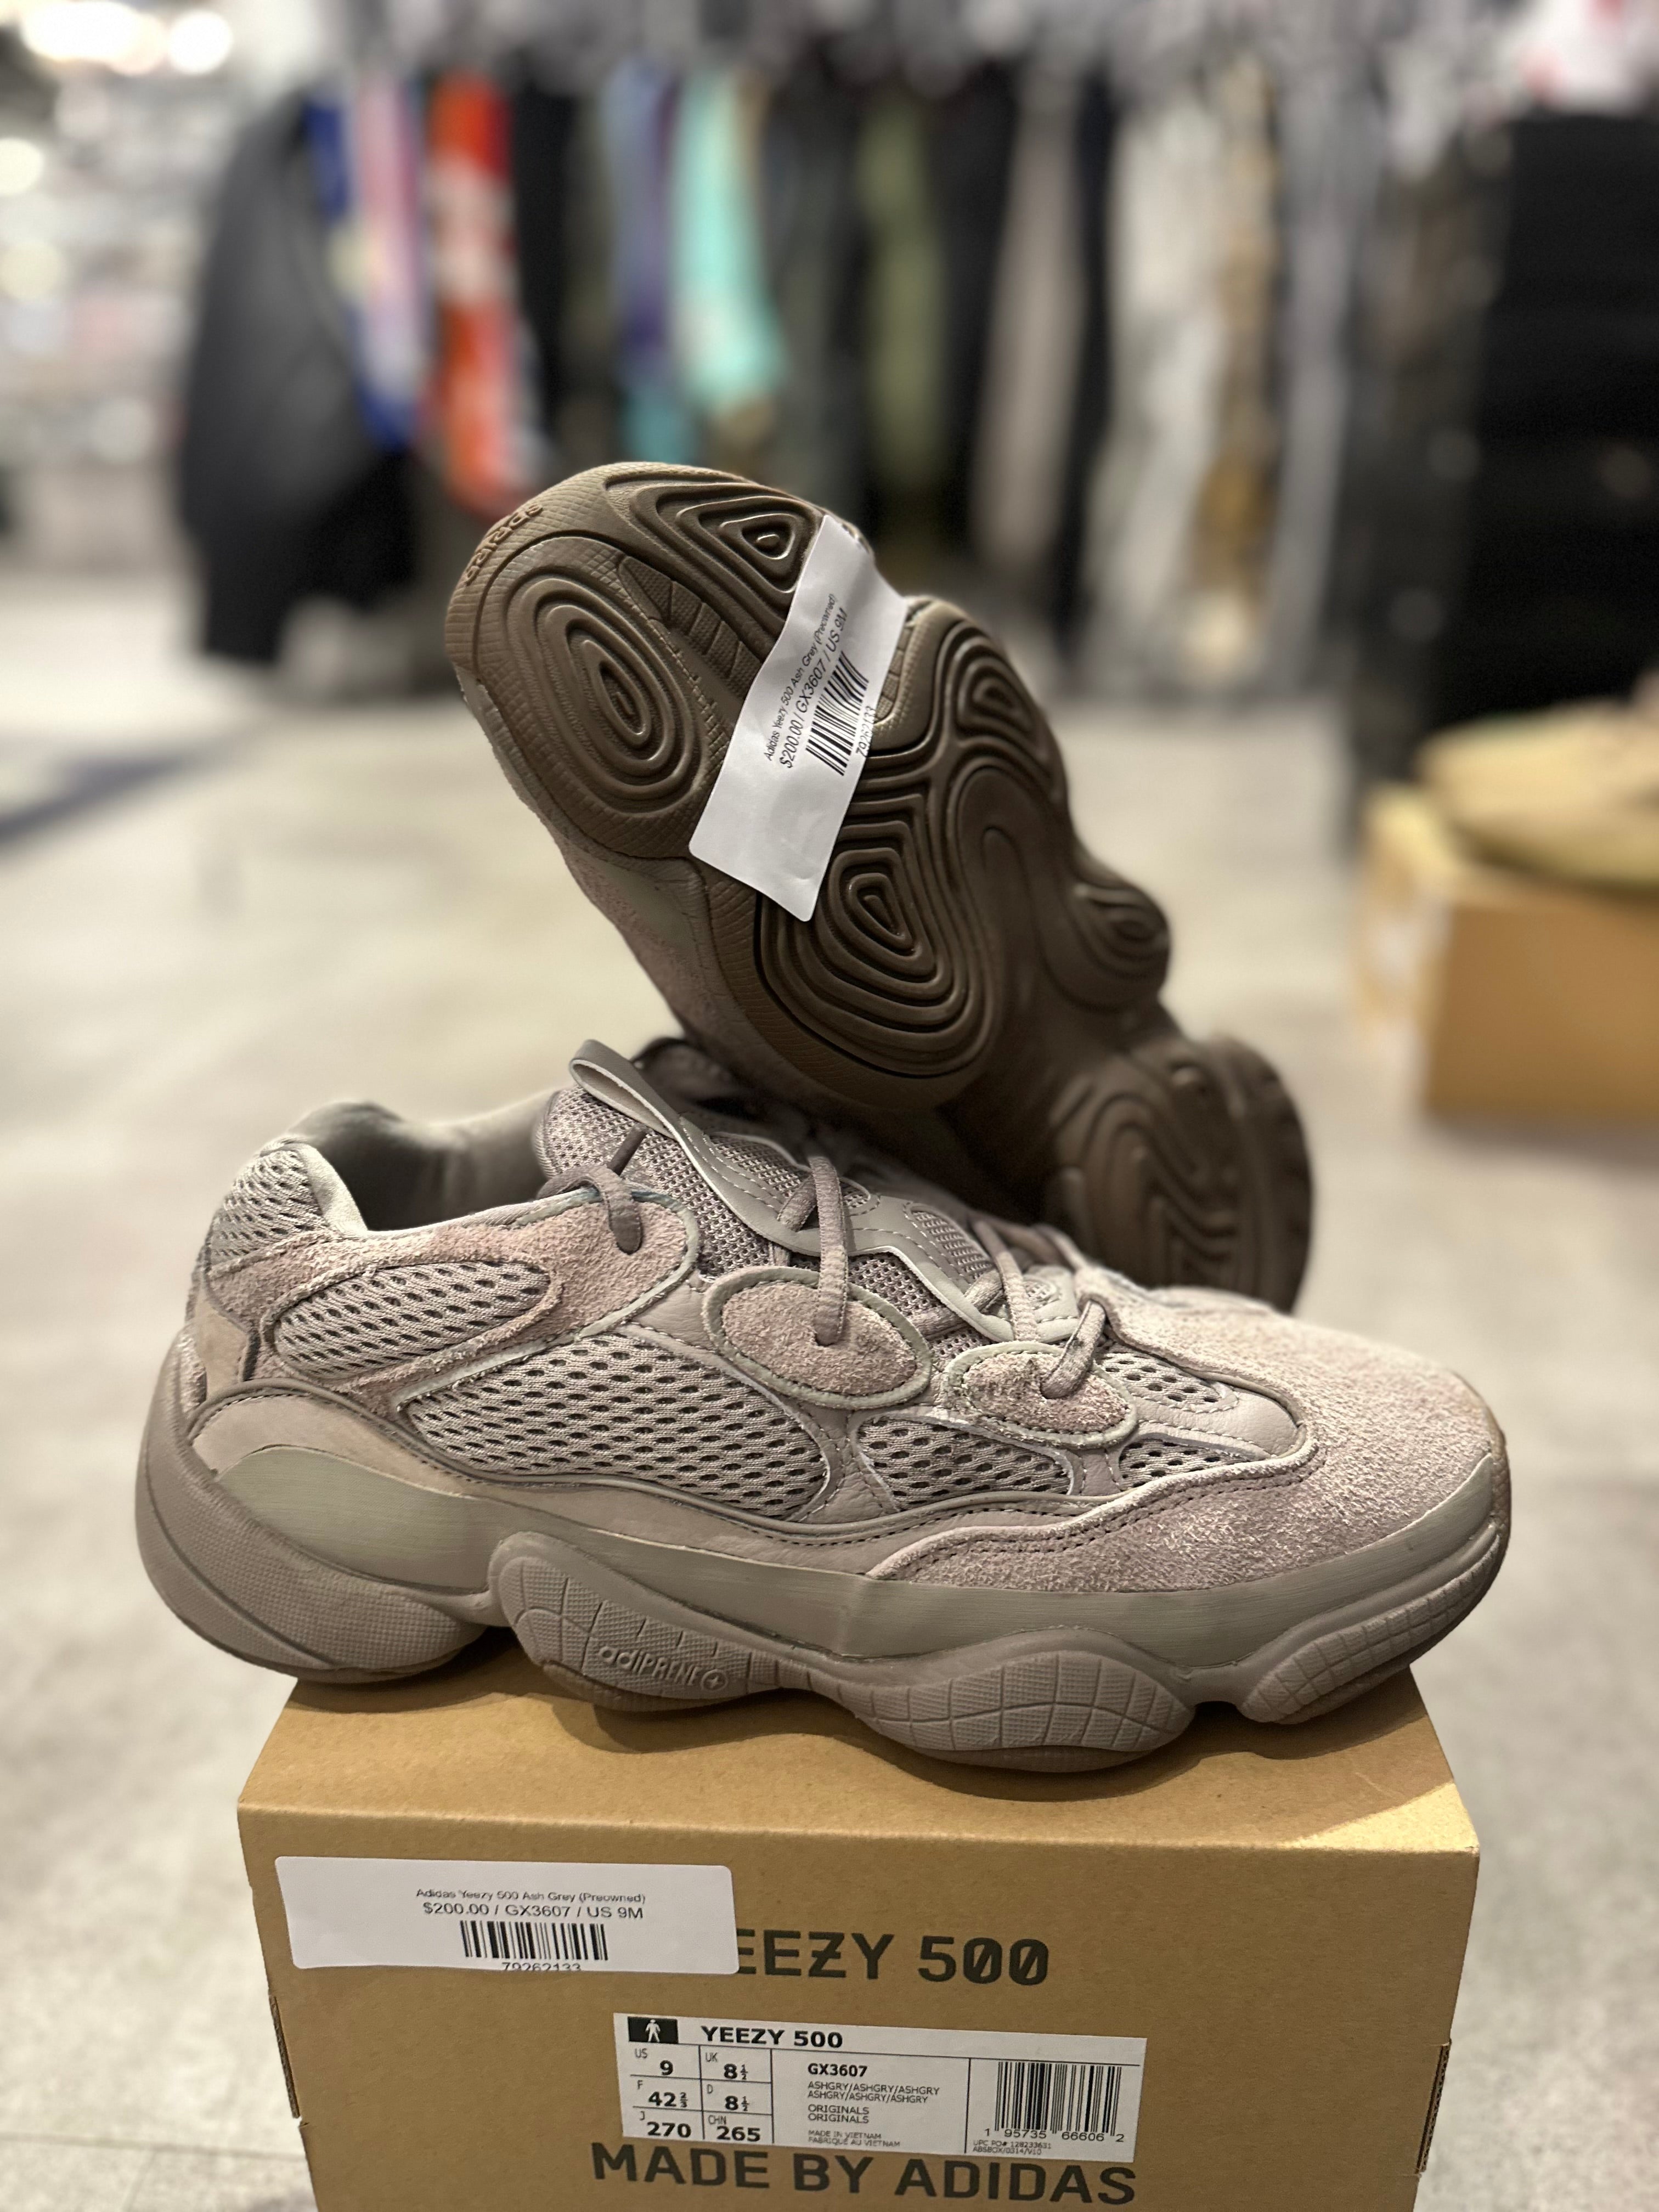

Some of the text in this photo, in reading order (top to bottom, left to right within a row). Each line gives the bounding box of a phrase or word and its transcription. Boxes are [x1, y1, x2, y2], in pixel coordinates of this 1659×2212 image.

[780, 719, 804, 769] $200.00
[795, 658, 828, 713] GX3607
[826, 629, 840, 652] US
[834, 607, 848, 631] 9M
[763, 731, 780, 761] Adidas
[772, 708, 788, 730] Yeezy
[781, 686, 794, 706] 500
[791, 667, 804, 686] Ash
[802, 642, 818, 667] Grey
[416, 1888, 646, 1904] Adidas Yeezy 500 Ash Grey (Preowned)
[423, 1901, 489, 1915] $200.00
[505, 1904, 571, 1917] GX3607
[586, 1906, 612, 1918] US
[618, 1906, 644, 1919] 9M
[918, 1935, 1049, 1986] 500
[701, 2025, 843, 2049] YEEZY 500
[635, 2048, 648, 2059] US
[706, 2052, 718, 2063] UK
[659, 2060, 674, 2076] 9
[808, 2062, 868, 2077] GX3607
[637, 2080, 643, 2090] F
[707, 2084, 713, 2095] D
[808, 2081, 940, 2095] ASHGRY/ASHGRY/ASHGRY
[808, 2090, 928, 2103] ASHGRY/ASHGRY/ASHGRY
[640, 2112, 646, 2121] J
[808, 2104, 870, 2115] ORIGINALS
[708, 2115, 727, 2125] CHN
[808, 2113, 870, 2124] ORIGINALS
[646, 2121, 692, 2138] 270
[716, 2126, 761, 2142] 265
[808, 2129, 831, 2137] MADE
[985, 2128, 1125, 2142] 1 95735 66606 2
[592, 2142, 1136, 2205] MADE BY ADIDAS
